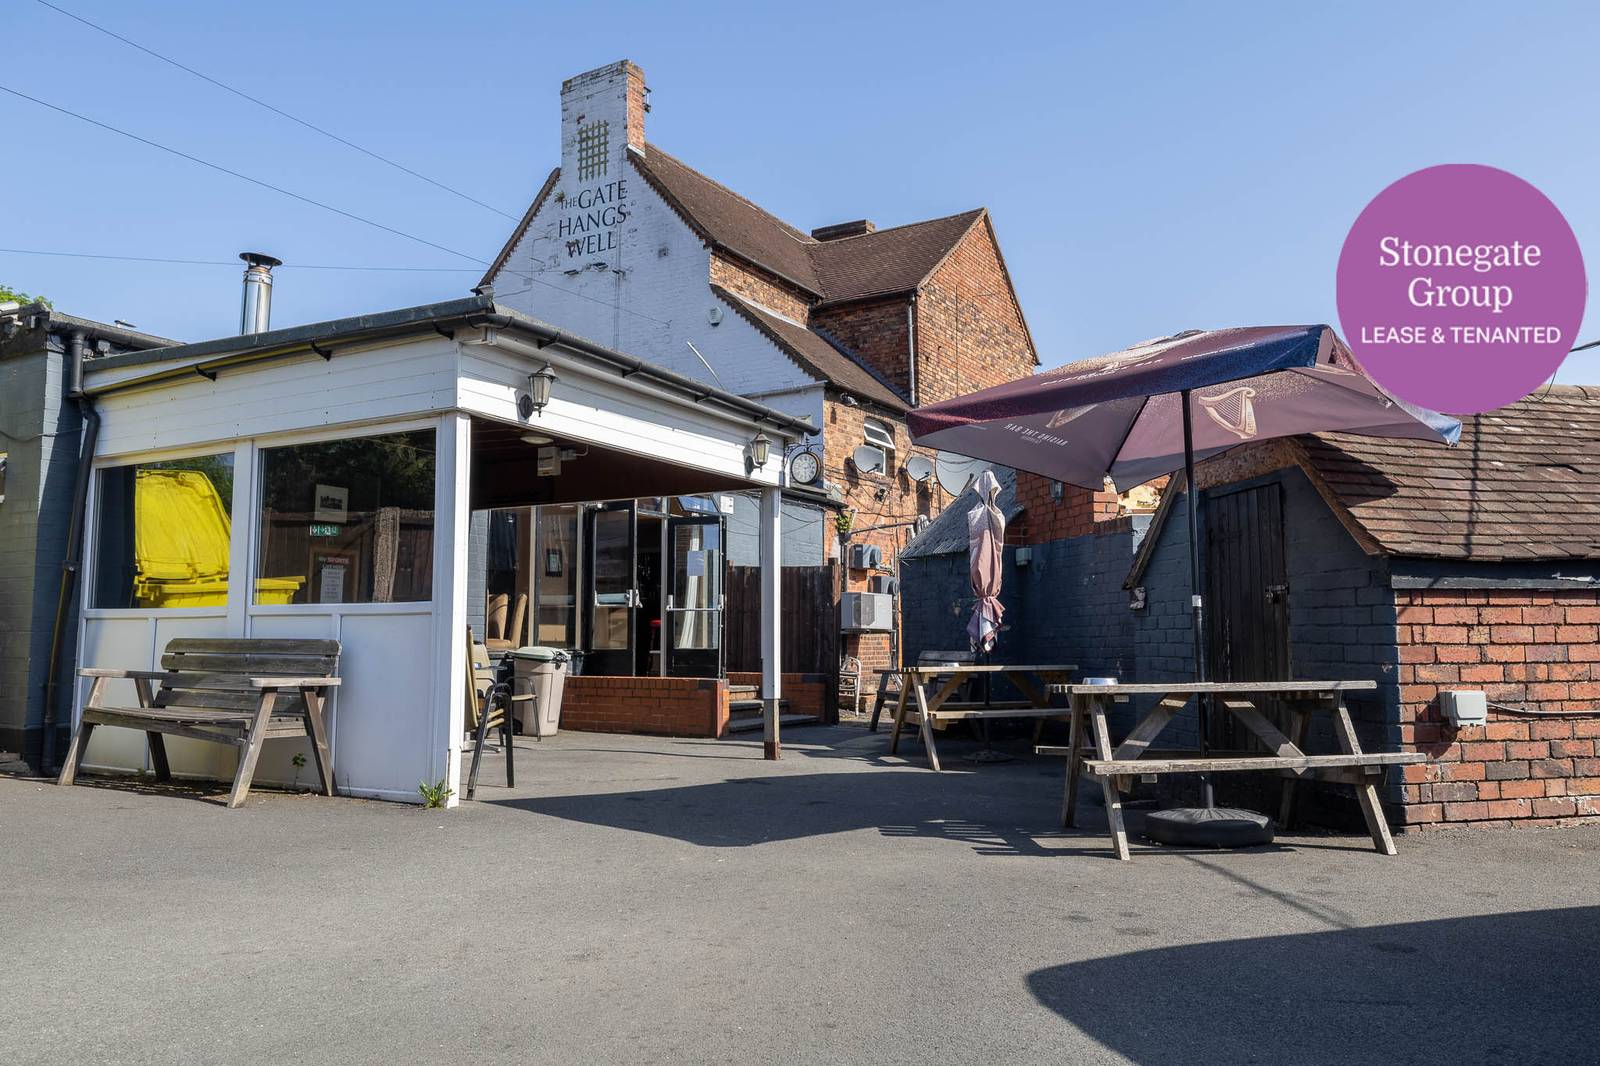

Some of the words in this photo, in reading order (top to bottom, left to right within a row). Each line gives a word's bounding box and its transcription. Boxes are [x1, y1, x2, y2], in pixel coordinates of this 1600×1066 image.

[560, 197, 577, 209] THE
[578, 180, 627, 209] GATE
[559, 204, 627, 238] HANGS
[566, 231, 617, 258] WELL
